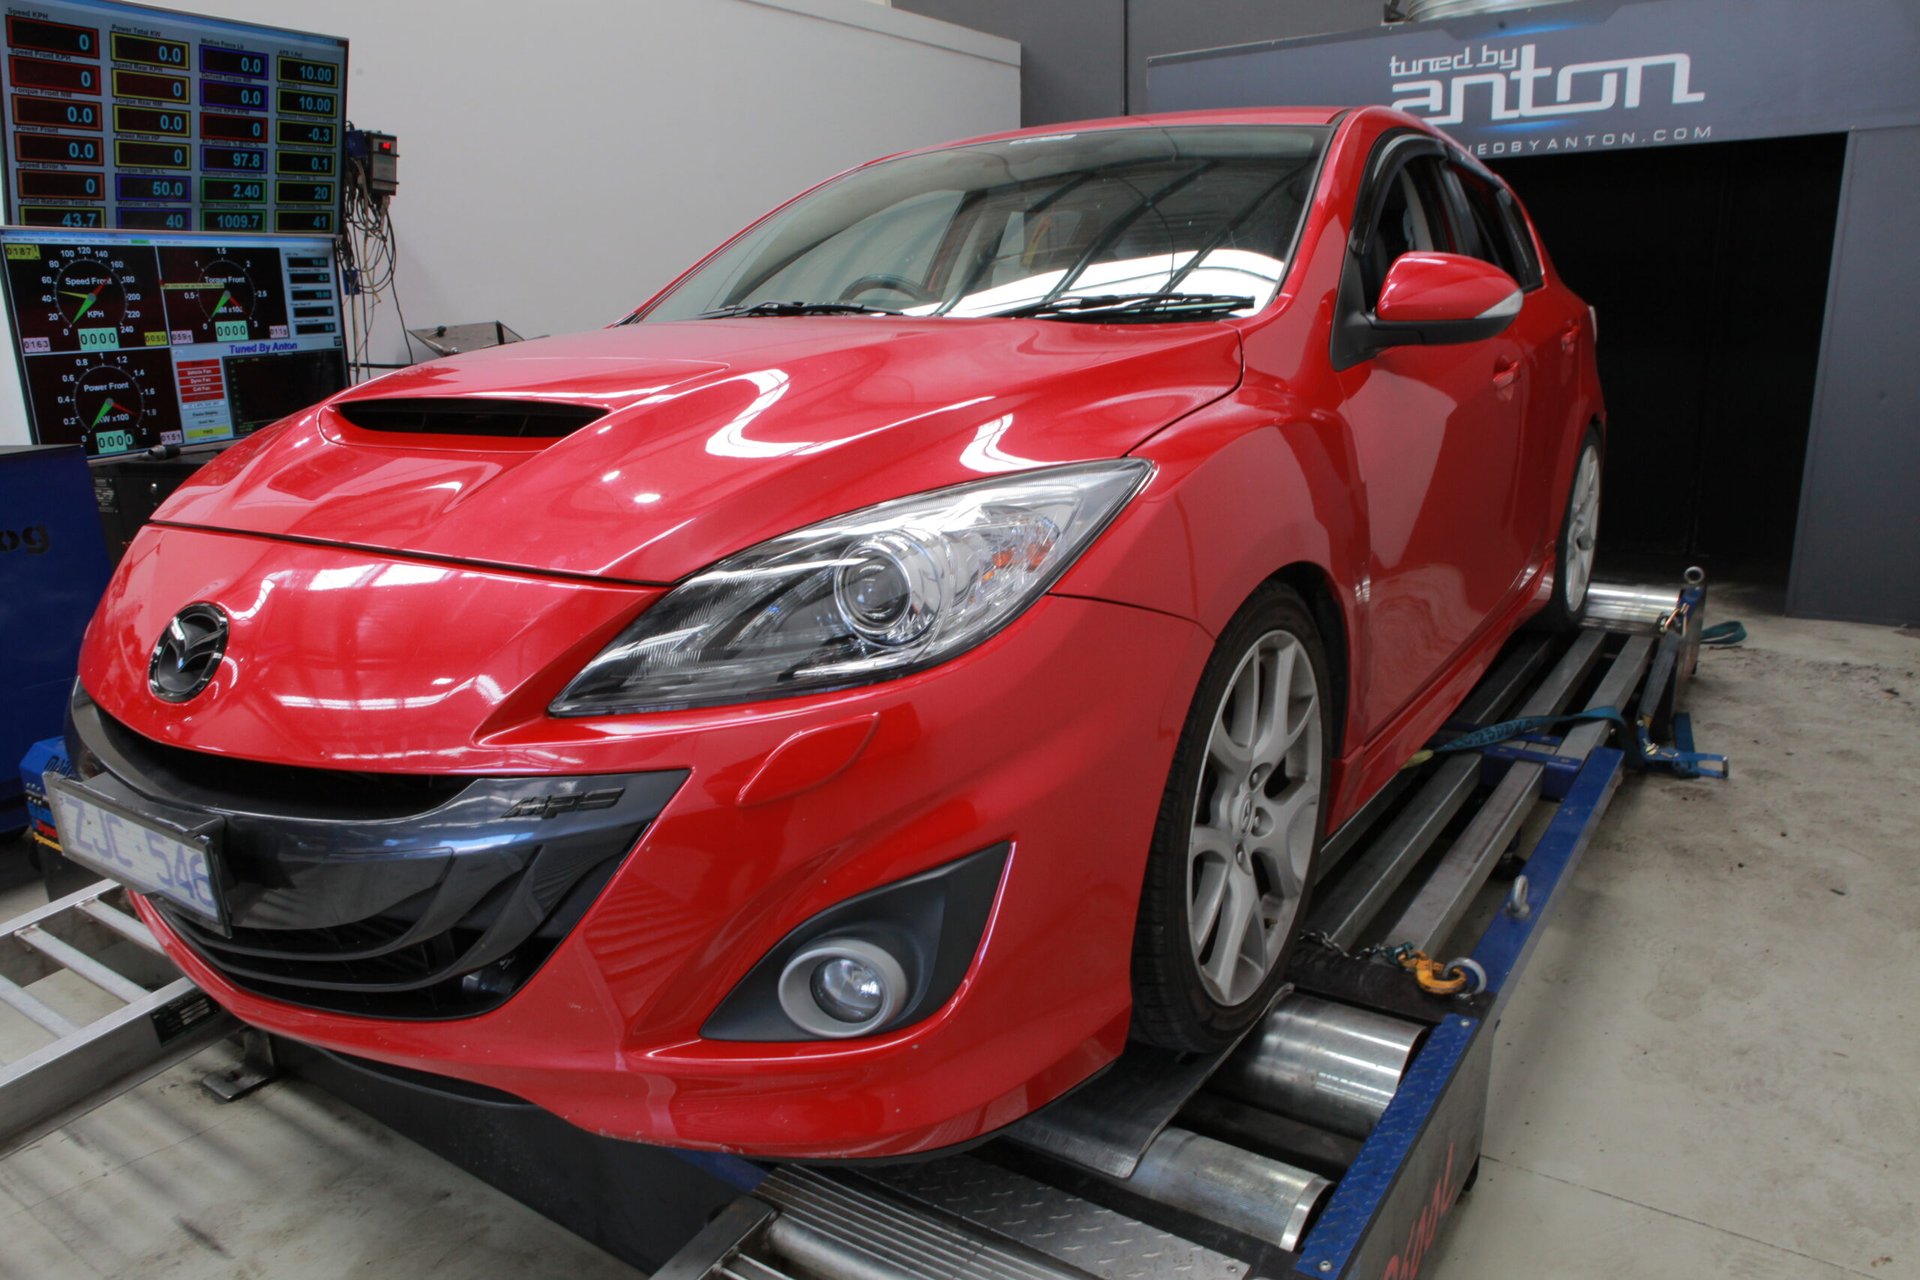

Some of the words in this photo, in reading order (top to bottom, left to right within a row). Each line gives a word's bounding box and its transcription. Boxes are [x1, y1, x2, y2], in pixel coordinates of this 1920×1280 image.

[8, 8, 30, 17] Speed
[32, 12, 48, 20] KPH
[79, 34, 89, 50] 0
[159, 46, 181, 63] 0.0
[1389, 47, 1473, 77] tuned
[1478, 45, 1517, 70] by
[241, 57, 261, 73] 0.0
[81, 71, 91, 87] 0
[300, 65, 331, 82] 10.00
[173, 82, 182, 97] 0
[1391, 44, 1706, 126] anton
[241, 90, 261, 105] 0.0
[299, 96, 331, 112] 10.00
[67, 106, 93, 123] 0.0
[160, 115, 182, 131] 0.0
[252, 123, 261, 137] 0
[308, 128, 330, 142] -0.3
[68, 142, 94, 159] 0.0
[174, 149, 183, 164] 0
[233, 153, 260, 168] 97.8
[311, 157, 328, 171] 0.1
[85, 178, 95, 194] 0
[153, 182, 183, 196] 50.0
[233, 184, 260, 198] 2.40
[314, 187, 328, 200] 20
[62, 213, 96, 228] 43.7
[166, 214, 183, 228] 40
[217, 215, 260, 229] 1009.7
[313, 216, 327, 228] 41
[61, 250, 75, 258] 100
[77, 247, 92, 255] 120
[95, 250, 108, 258] 140
[65, 277, 90, 286] Speed
[42, 294, 51, 302] 40
[184, 292, 195, 300] 0.5
[63, 328, 69, 336] 0
[121, 326, 134, 334] 240
[230, 344, 256, 354] Tuned
[259, 343, 270, 354] By
[272, 341, 298, 351] Anton
[117, 356, 128, 364] 1.2
[134, 369, 145, 377] 1.4
[84, 384, 107, 392] Power
[109, 382, 129, 390] Front
[57, 396, 70, 404] 0.4
[112, 413, 129, 421] x100
[141, 427, 147, 435] 2
